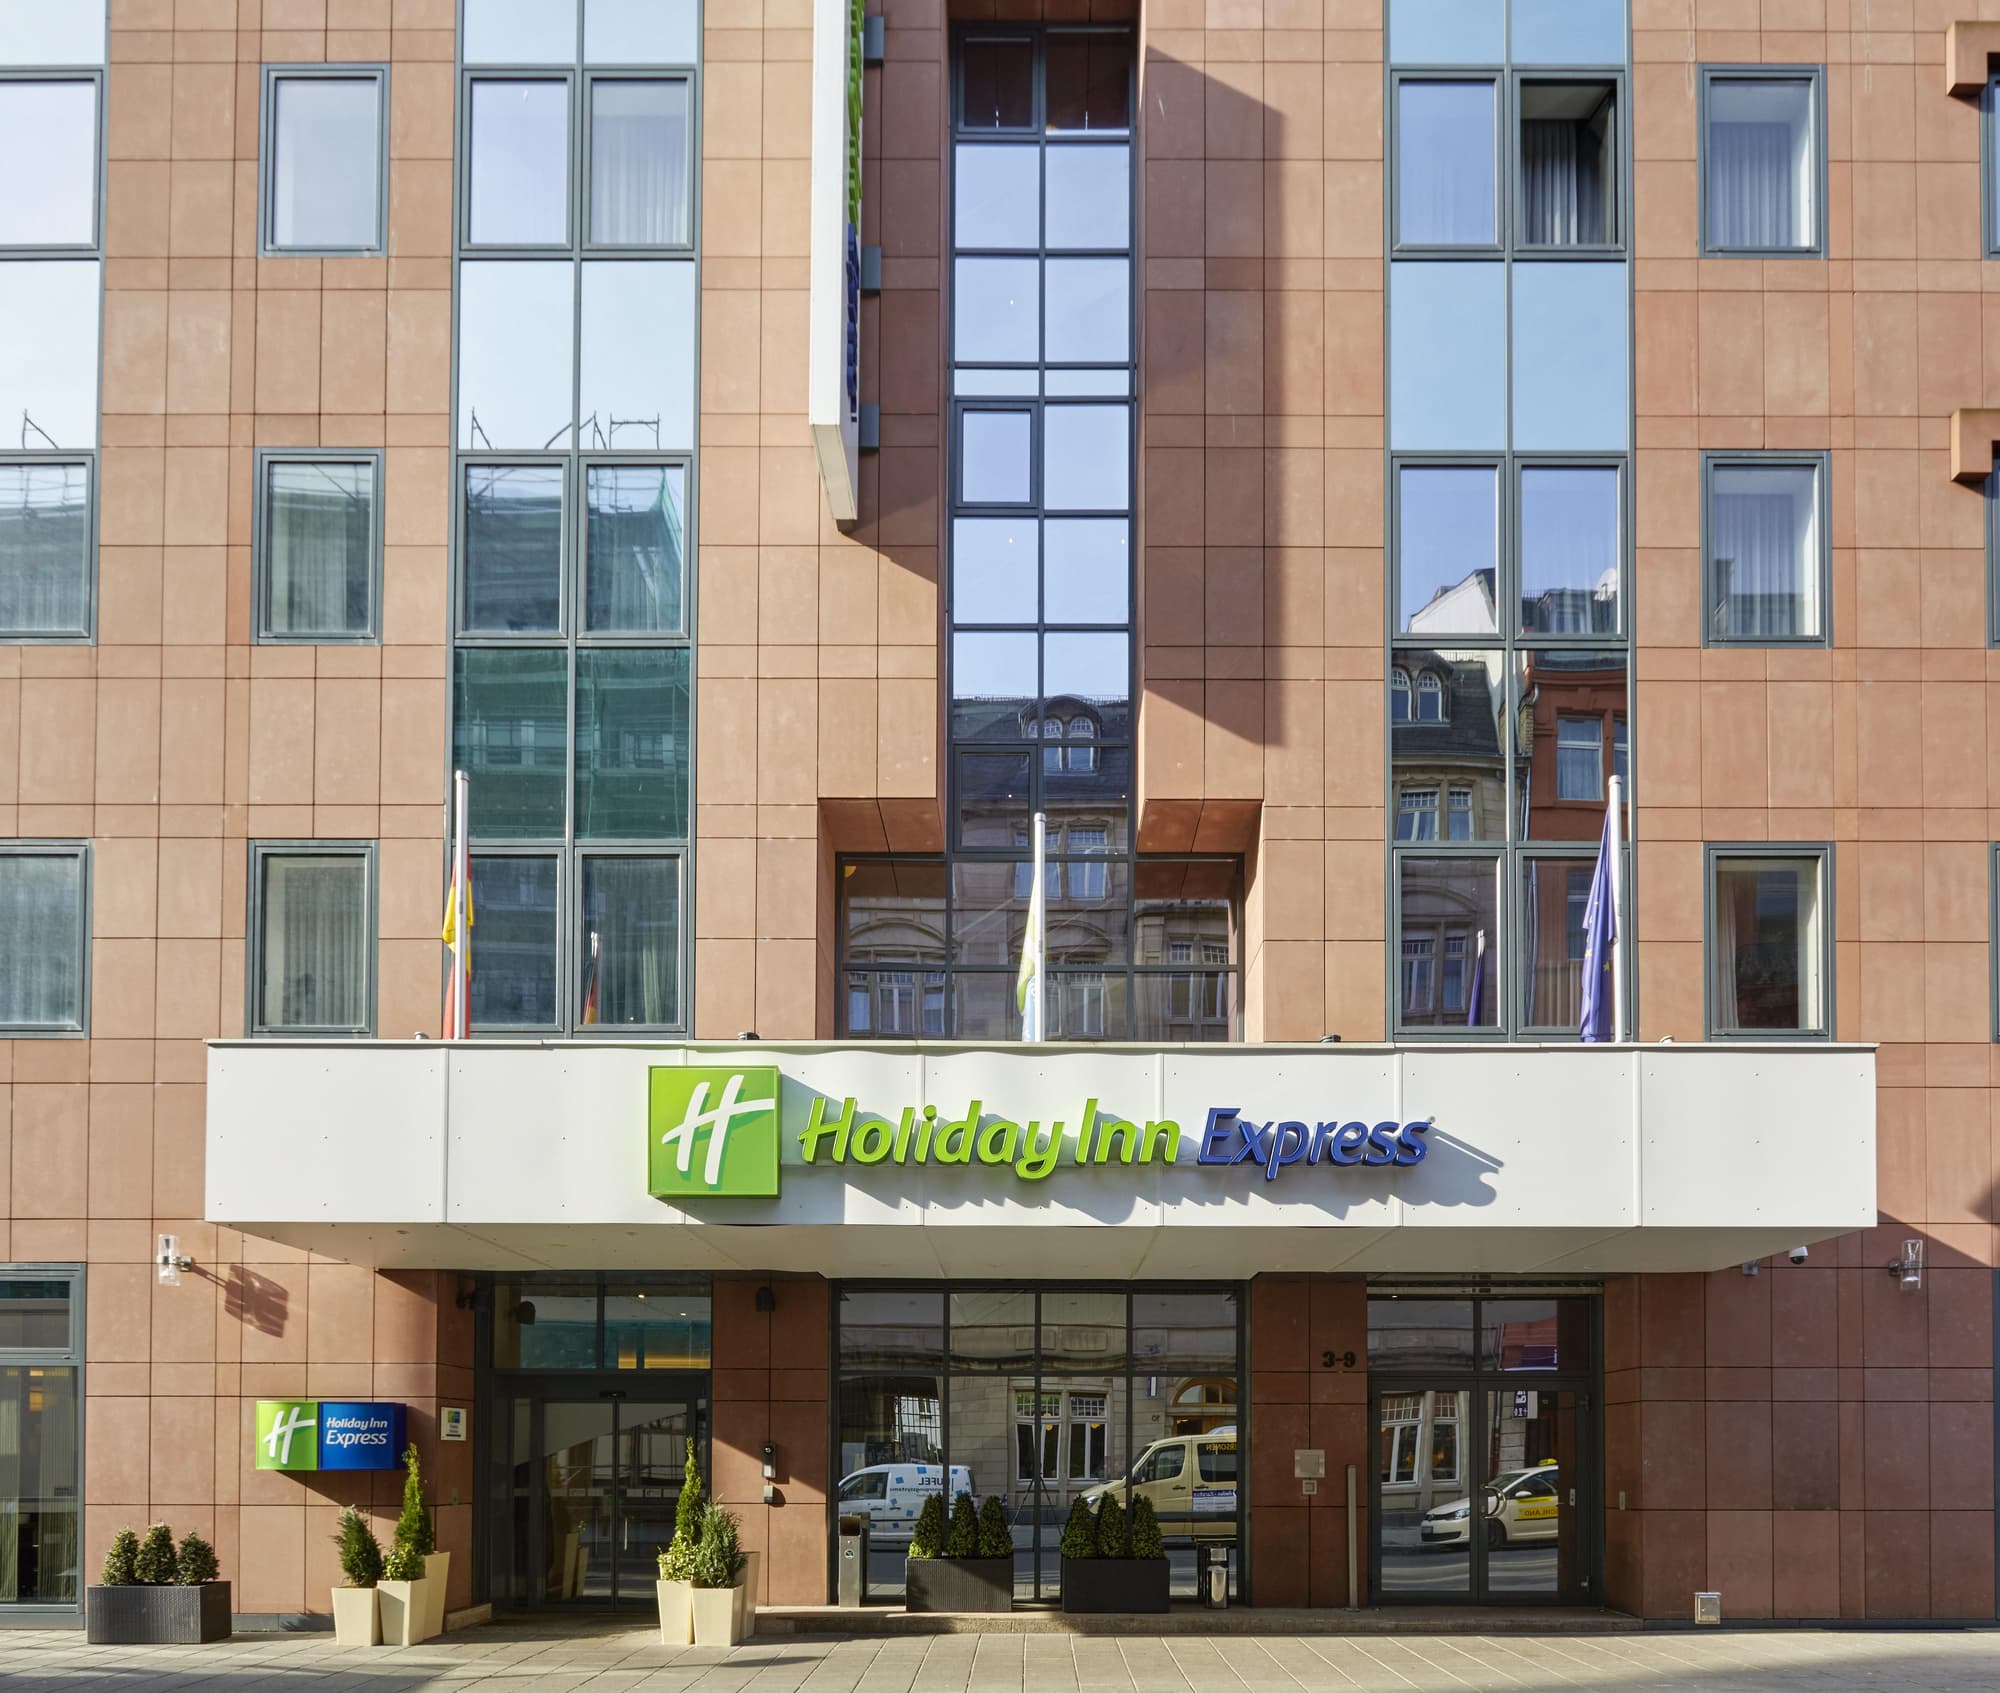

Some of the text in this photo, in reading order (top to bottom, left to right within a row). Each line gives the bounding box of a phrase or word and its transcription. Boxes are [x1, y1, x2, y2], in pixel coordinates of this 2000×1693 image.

[797, 1096, 1431, 1182] Holiday Inn Express
[1322, 1351, 1356, 1369] 3-9
[326, 1417, 388, 1430] Holiday Inn
[326, 1430, 387, 1448] Express
